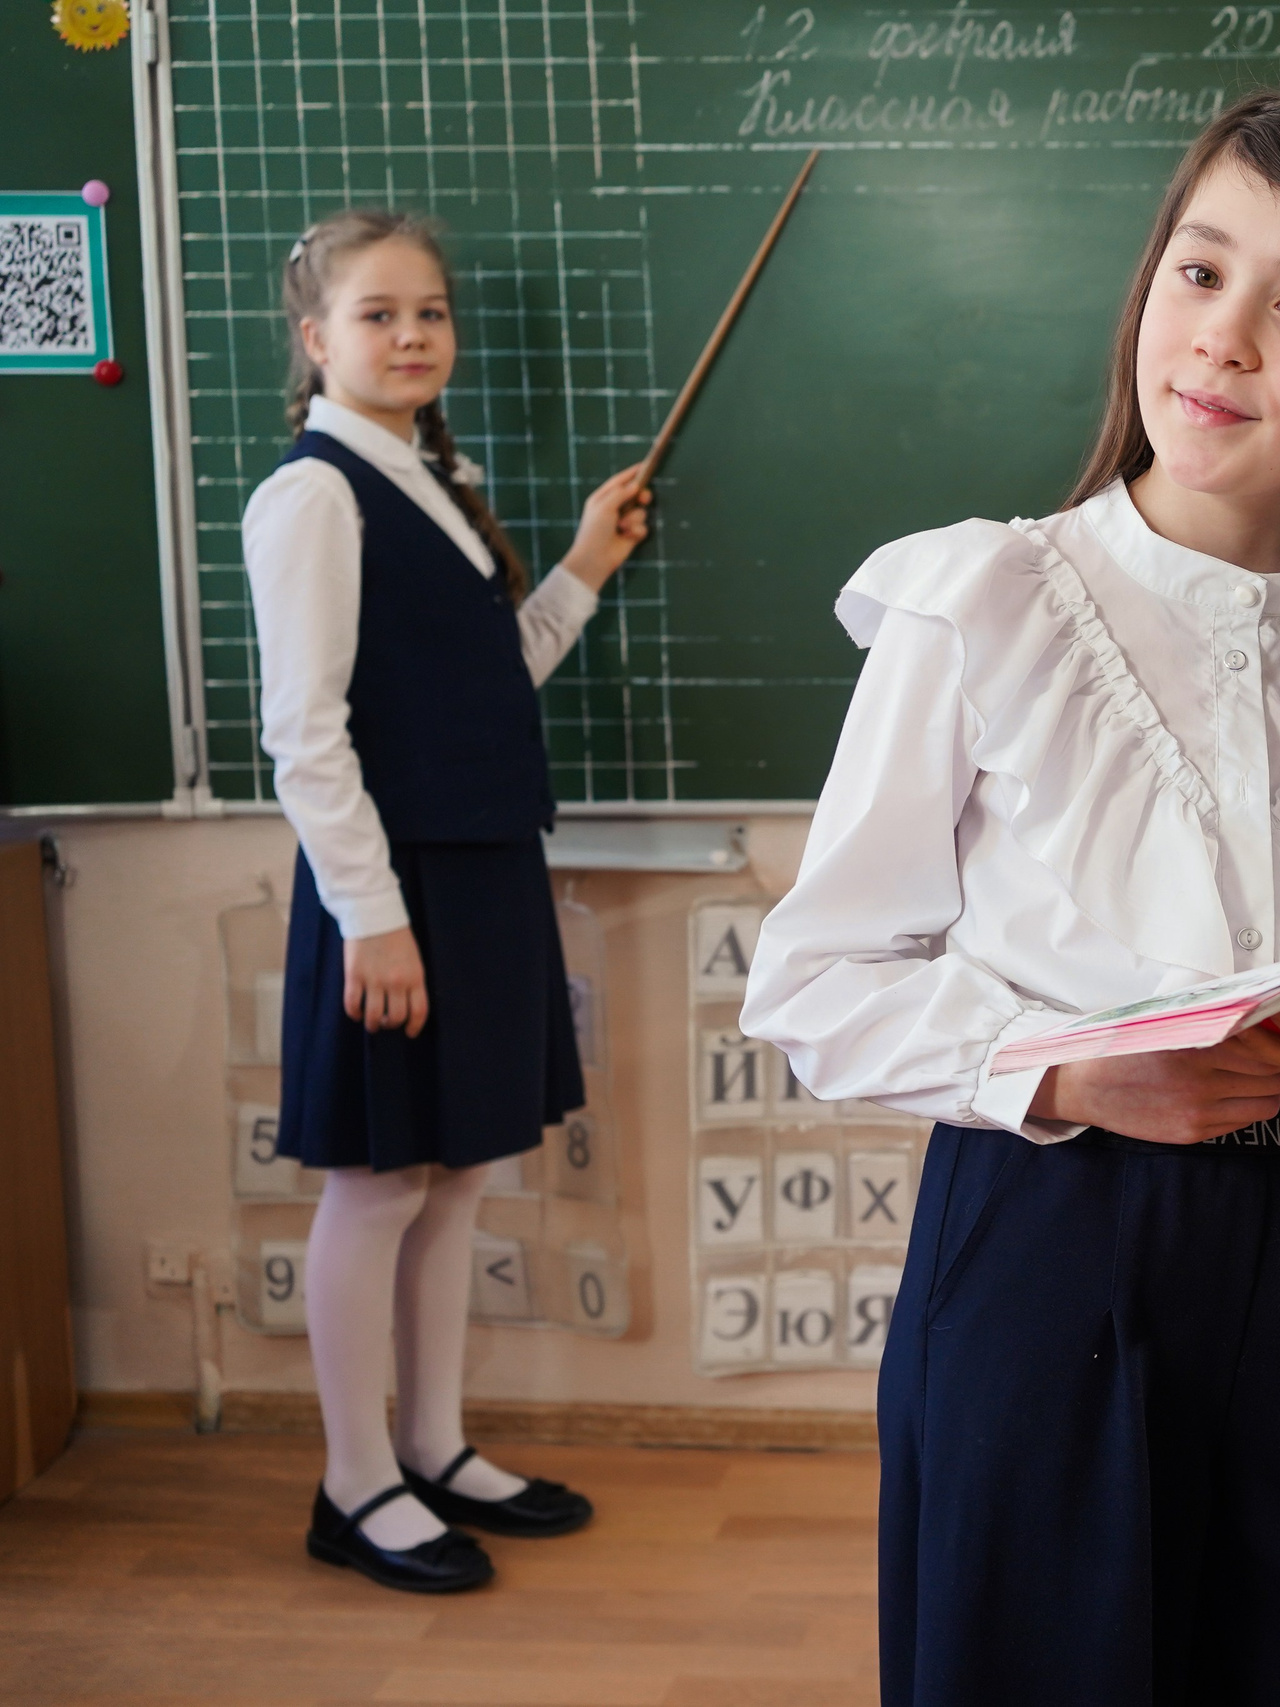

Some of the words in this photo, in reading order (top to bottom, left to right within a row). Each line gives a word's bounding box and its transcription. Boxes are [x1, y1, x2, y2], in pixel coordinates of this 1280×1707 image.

[740, 4, 820, 61] 12
[866, 0, 1078, 91] февраля
[737, 69, 1015, 137] Классная
[1040, 56, 1226, 140] работа
[702, 922, 750, 977] А
[712, 1035, 757, 1103] Й
[251, 1117, 277, 1165] 5
[566, 1120, 591, 1170] 8
[704, 1176, 758, 1233] У
[781, 1168, 832, 1212] Ф
[264, 1255, 295, 1302] 9
[711, 1286, 760, 1342] Э
[848, 1293, 894, 1347] Я
